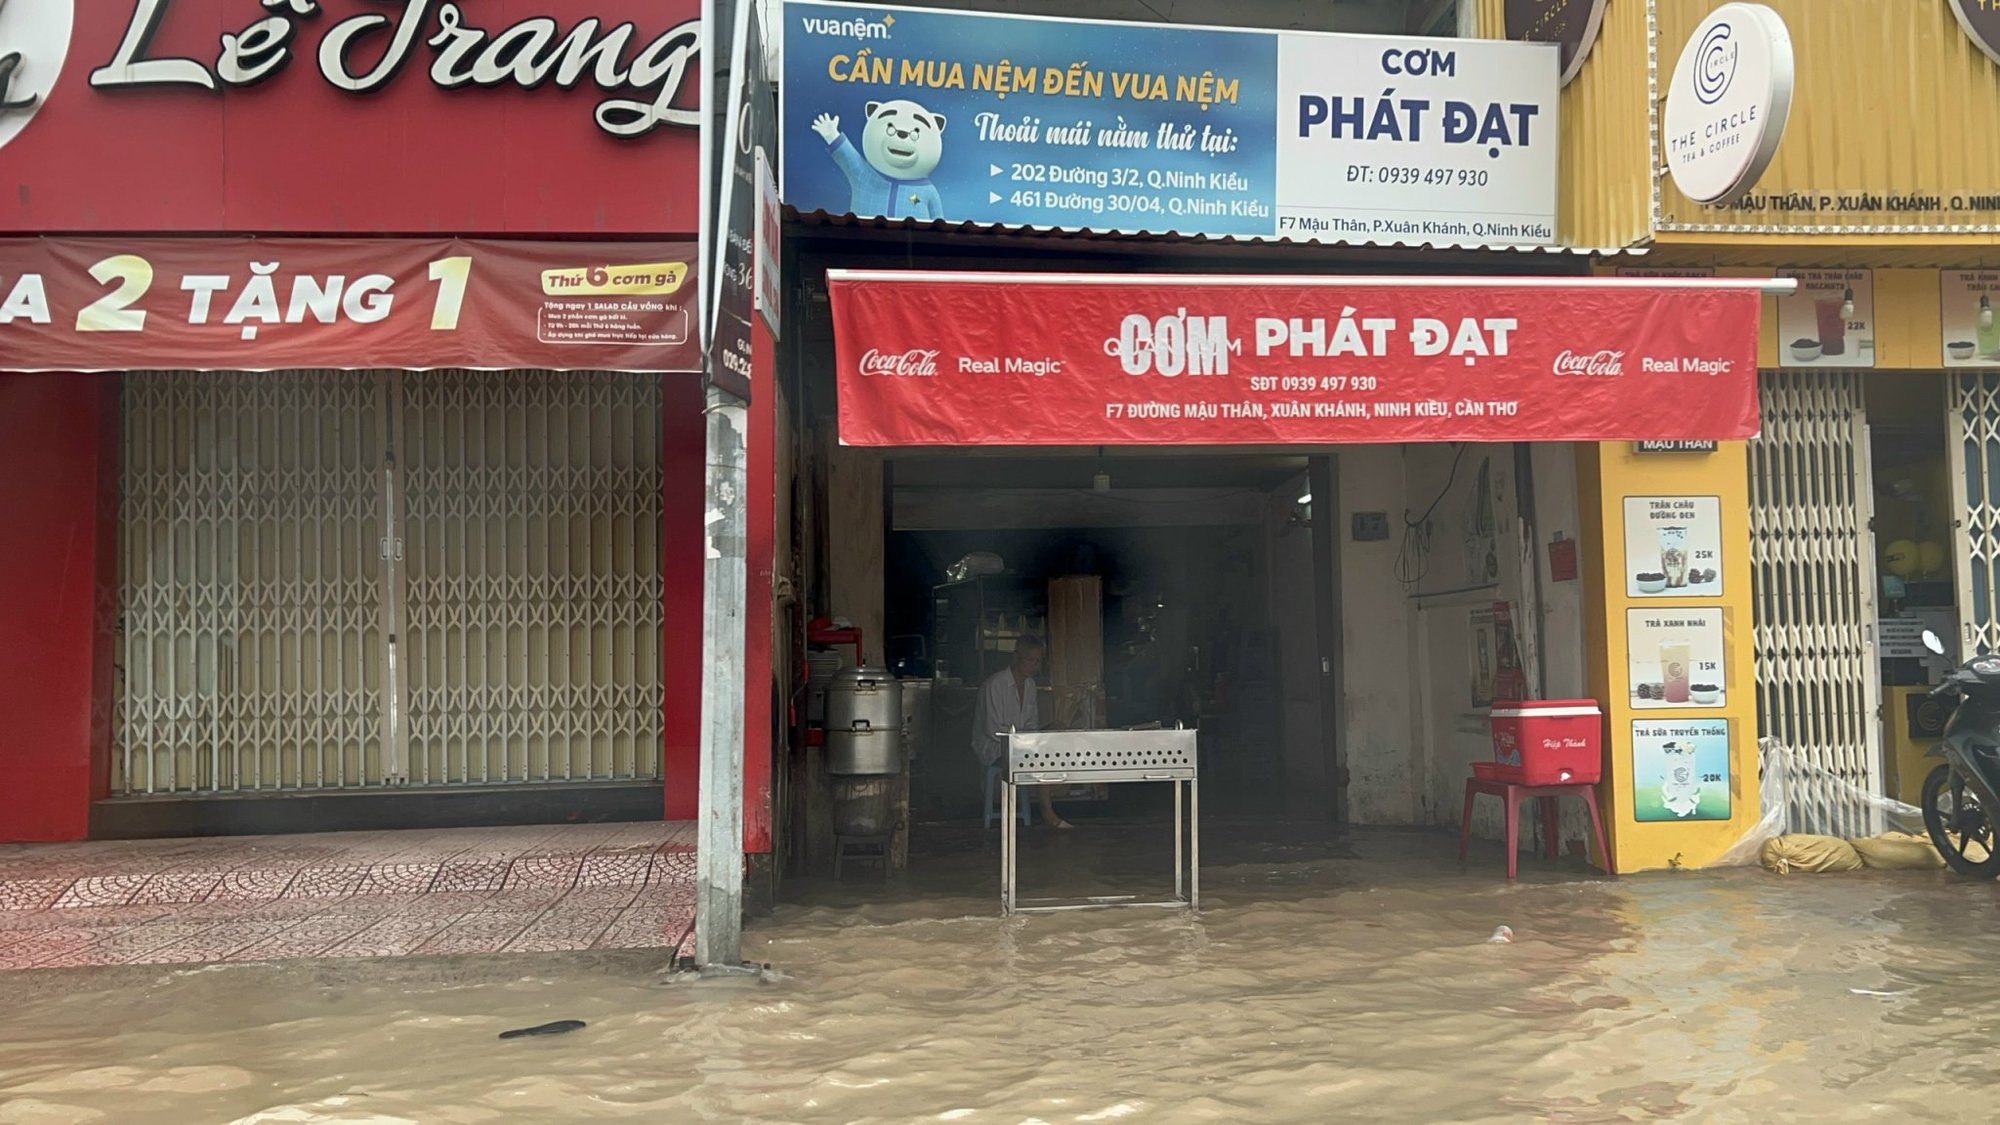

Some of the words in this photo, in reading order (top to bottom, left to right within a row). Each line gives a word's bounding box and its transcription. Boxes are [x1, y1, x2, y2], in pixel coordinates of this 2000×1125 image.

[803, 18, 891, 41] vuanệm
[316, 0, 700, 139] Trang
[1381, 48, 1456, 77] CƠM
[828, 47, 893, 84] CẦN
[900, 59, 965, 89] MUA
[972, 59, 1038, 100] NỆM
[1043, 61, 1104, 97] ĐẾN
[1111, 72, 1169, 101] VUA
[1176, 70, 1240, 111] NỆM
[974, 112, 1040, 143] Thoải
[1046, 120, 1092, 146] mái
[1097, 115, 1150, 149] nằm
[1156, 122, 1197, 151] thử
[1201, 125, 1238, 157] tại:
[1299, 88, 1430, 142] PHÁT
[1442, 101, 1539, 158] ĐẠT
[1672, 131, 1696, 152] THE
[1705, 105, 1756, 138] CIRCLE
[1683, 151, 1696, 163] TEA
[1709, 133, 1740, 153] COFFEE
[1011, 164, 1046, 182] 202
[1050, 166, 1108, 188] Đường
[1112, 169, 1144, 189] 3/2,
[1148, 171, 1206, 190] Q.Ninh
[1346, 165, 1375, 182] ĐT:
[1378, 167, 1420, 185] 0939
[1424, 169, 1454, 186] 497
[1458, 170, 1488, 187] 930
[1010, 191, 1041, 208] 461
[1045, 191, 1104, 213] Đường
[1107, 194, 1165, 214] 30/04,
[1168, 196, 1227, 217] Q.Ninh
[1280, 216, 1296, 229] F7
[1300, 217, 1329, 233] Mậu
[1332, 218, 1370, 233] Thân,
[1373, 219, 1419, 234] P.Xuân
[1423, 221, 1470, 236] Khánh,
[1473, 222, 1518, 237] Q.Ninh
[548, 273, 583, 288] Thứ
[586, 263, 609, 287] 6
[612, 274, 651, 286] cơm
[0, 273, 51, 324] A
[75, 254, 153, 331] 2
[180, 261, 396, 340] TẶNG
[428, 256, 472, 330] 1
[665, 304, 677, 312] khi
[1120, 307, 1229, 377] CƠM
[1255, 305, 1396, 356] PHÁT
[1409, 318, 1518, 366] ĐẠT
[958, 357, 1001, 373] Real
[1642, 358, 1679, 373] Real
[1250, 376, 1279, 391] SĐT
[1282, 376, 1317, 391] 0939
[1320, 376, 1347, 391] 497
[1350, 376, 1377, 391] 930
[1106, 403, 1124, 419] F7
[1127, 400, 1181, 419] ĐƯỜNG
[1184, 401, 1218, 421] MẬU
[1220, 400, 1267, 420] THÂN,
[1270, 401, 1312, 418] XUÂN
[1315, 401, 1372, 420] KHÁNH,
[1374, 401, 1412, 418] NINH
[1455, 398, 1486, 417] CẦN
[1487, 401, 1519, 417] THƠ
[1695, 550, 1713, 559] 25K
[1645, 618, 1661, 628] TRÀ
[1699, 661, 1717, 671] 15K
[1703, 773, 1722, 782] 20K
